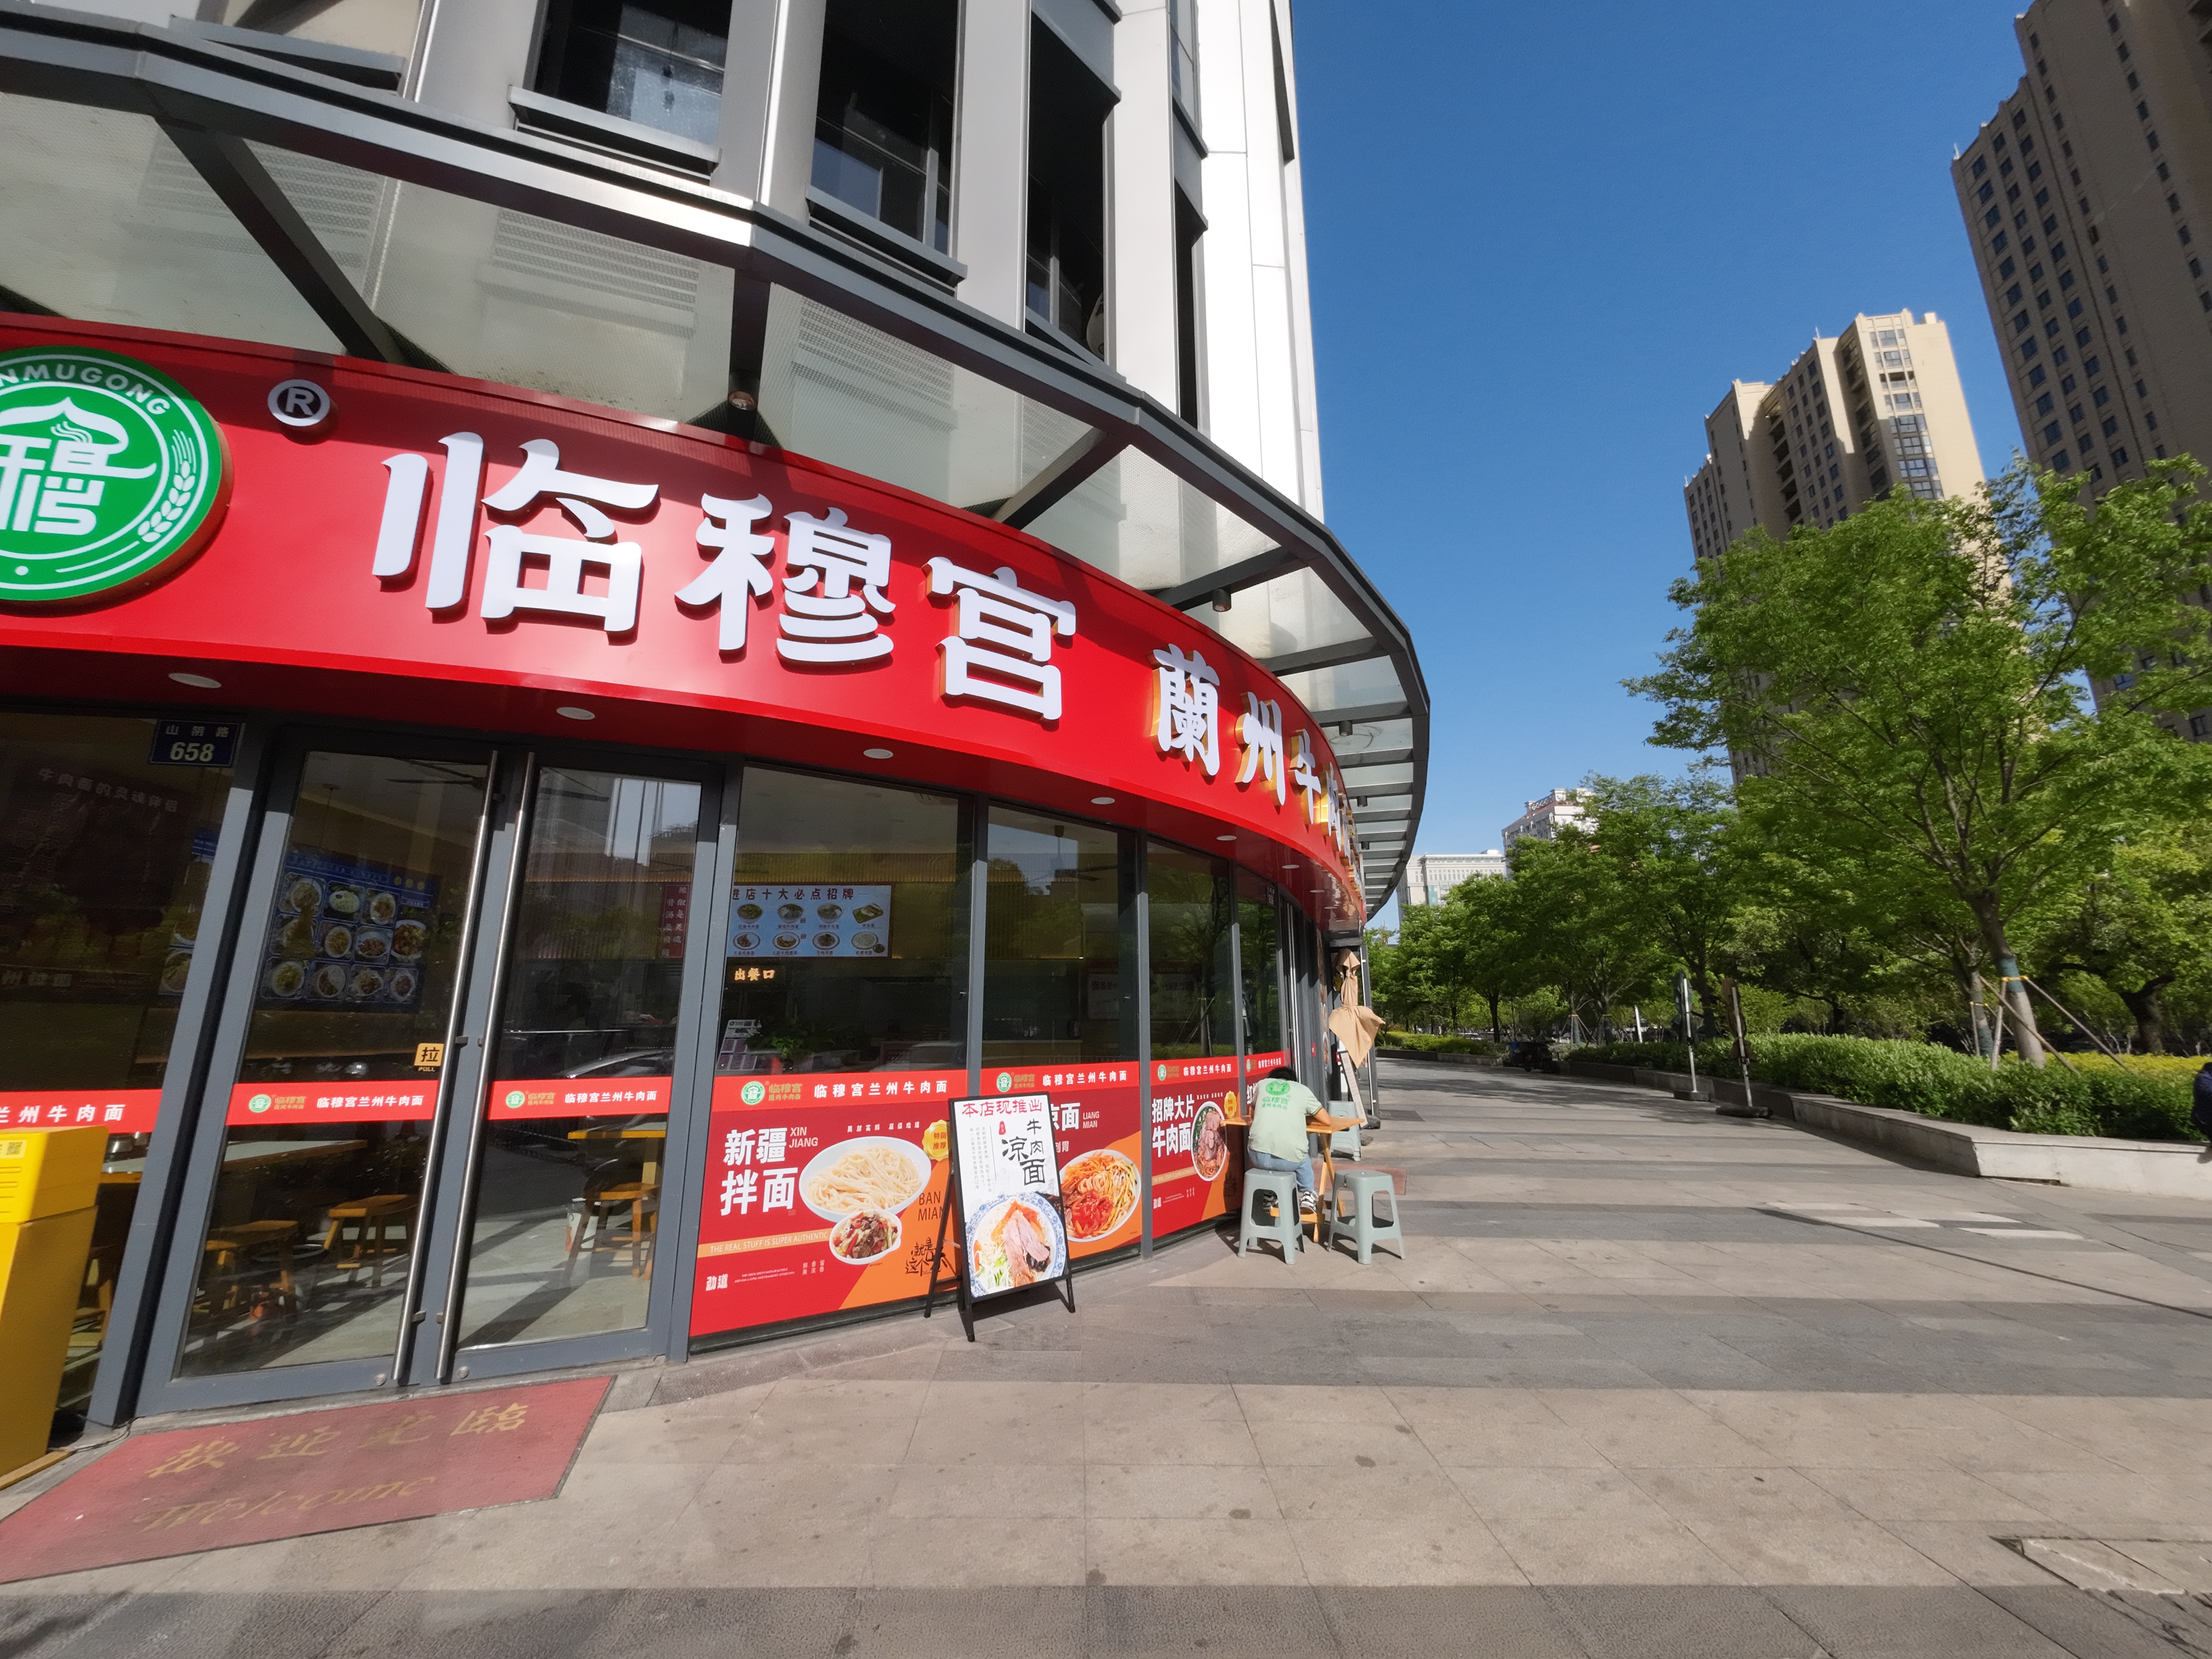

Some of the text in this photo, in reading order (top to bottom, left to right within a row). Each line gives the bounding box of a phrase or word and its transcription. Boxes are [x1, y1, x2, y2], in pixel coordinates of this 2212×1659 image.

[372, 431, 1076, 721] 临穆宫
[170, 742, 215, 763] 658
[734, 967, 775, 981] 出餐口
[420, 1047, 440, 1062] 拉
[1042, 1070, 1127, 1087] 临穆宫兰州牛肉面
[565, 1091, 658, 1104] 临穆宫兰州牛肉面
[769, 1080, 948, 1099] 临穆宫 临穆宫兰州牛肉面
[316, 1095, 424, 1109] 临穆宫兰州牛肉面
[962, 1098, 1043, 1118] 本店现推出
[1152, 1093, 1194, 1124] 招牌大片
[1082, 1111, 1099, 1120] LIANG
[790, 1126, 807, 1136] XIN
[1082, 1120, 1098, 1129] MIAN
[723, 1127, 787, 1166] 新疆
[789, 1137, 818, 1148] JIANG
[1152, 1121, 1191, 1158] 牛肉面
[720, 1167, 799, 1216] 拌面
[919, 1191, 941, 1206] BAN
[710, 1231, 828, 1253] THE REAL STUFF IS SUPER AUTHENTIC
